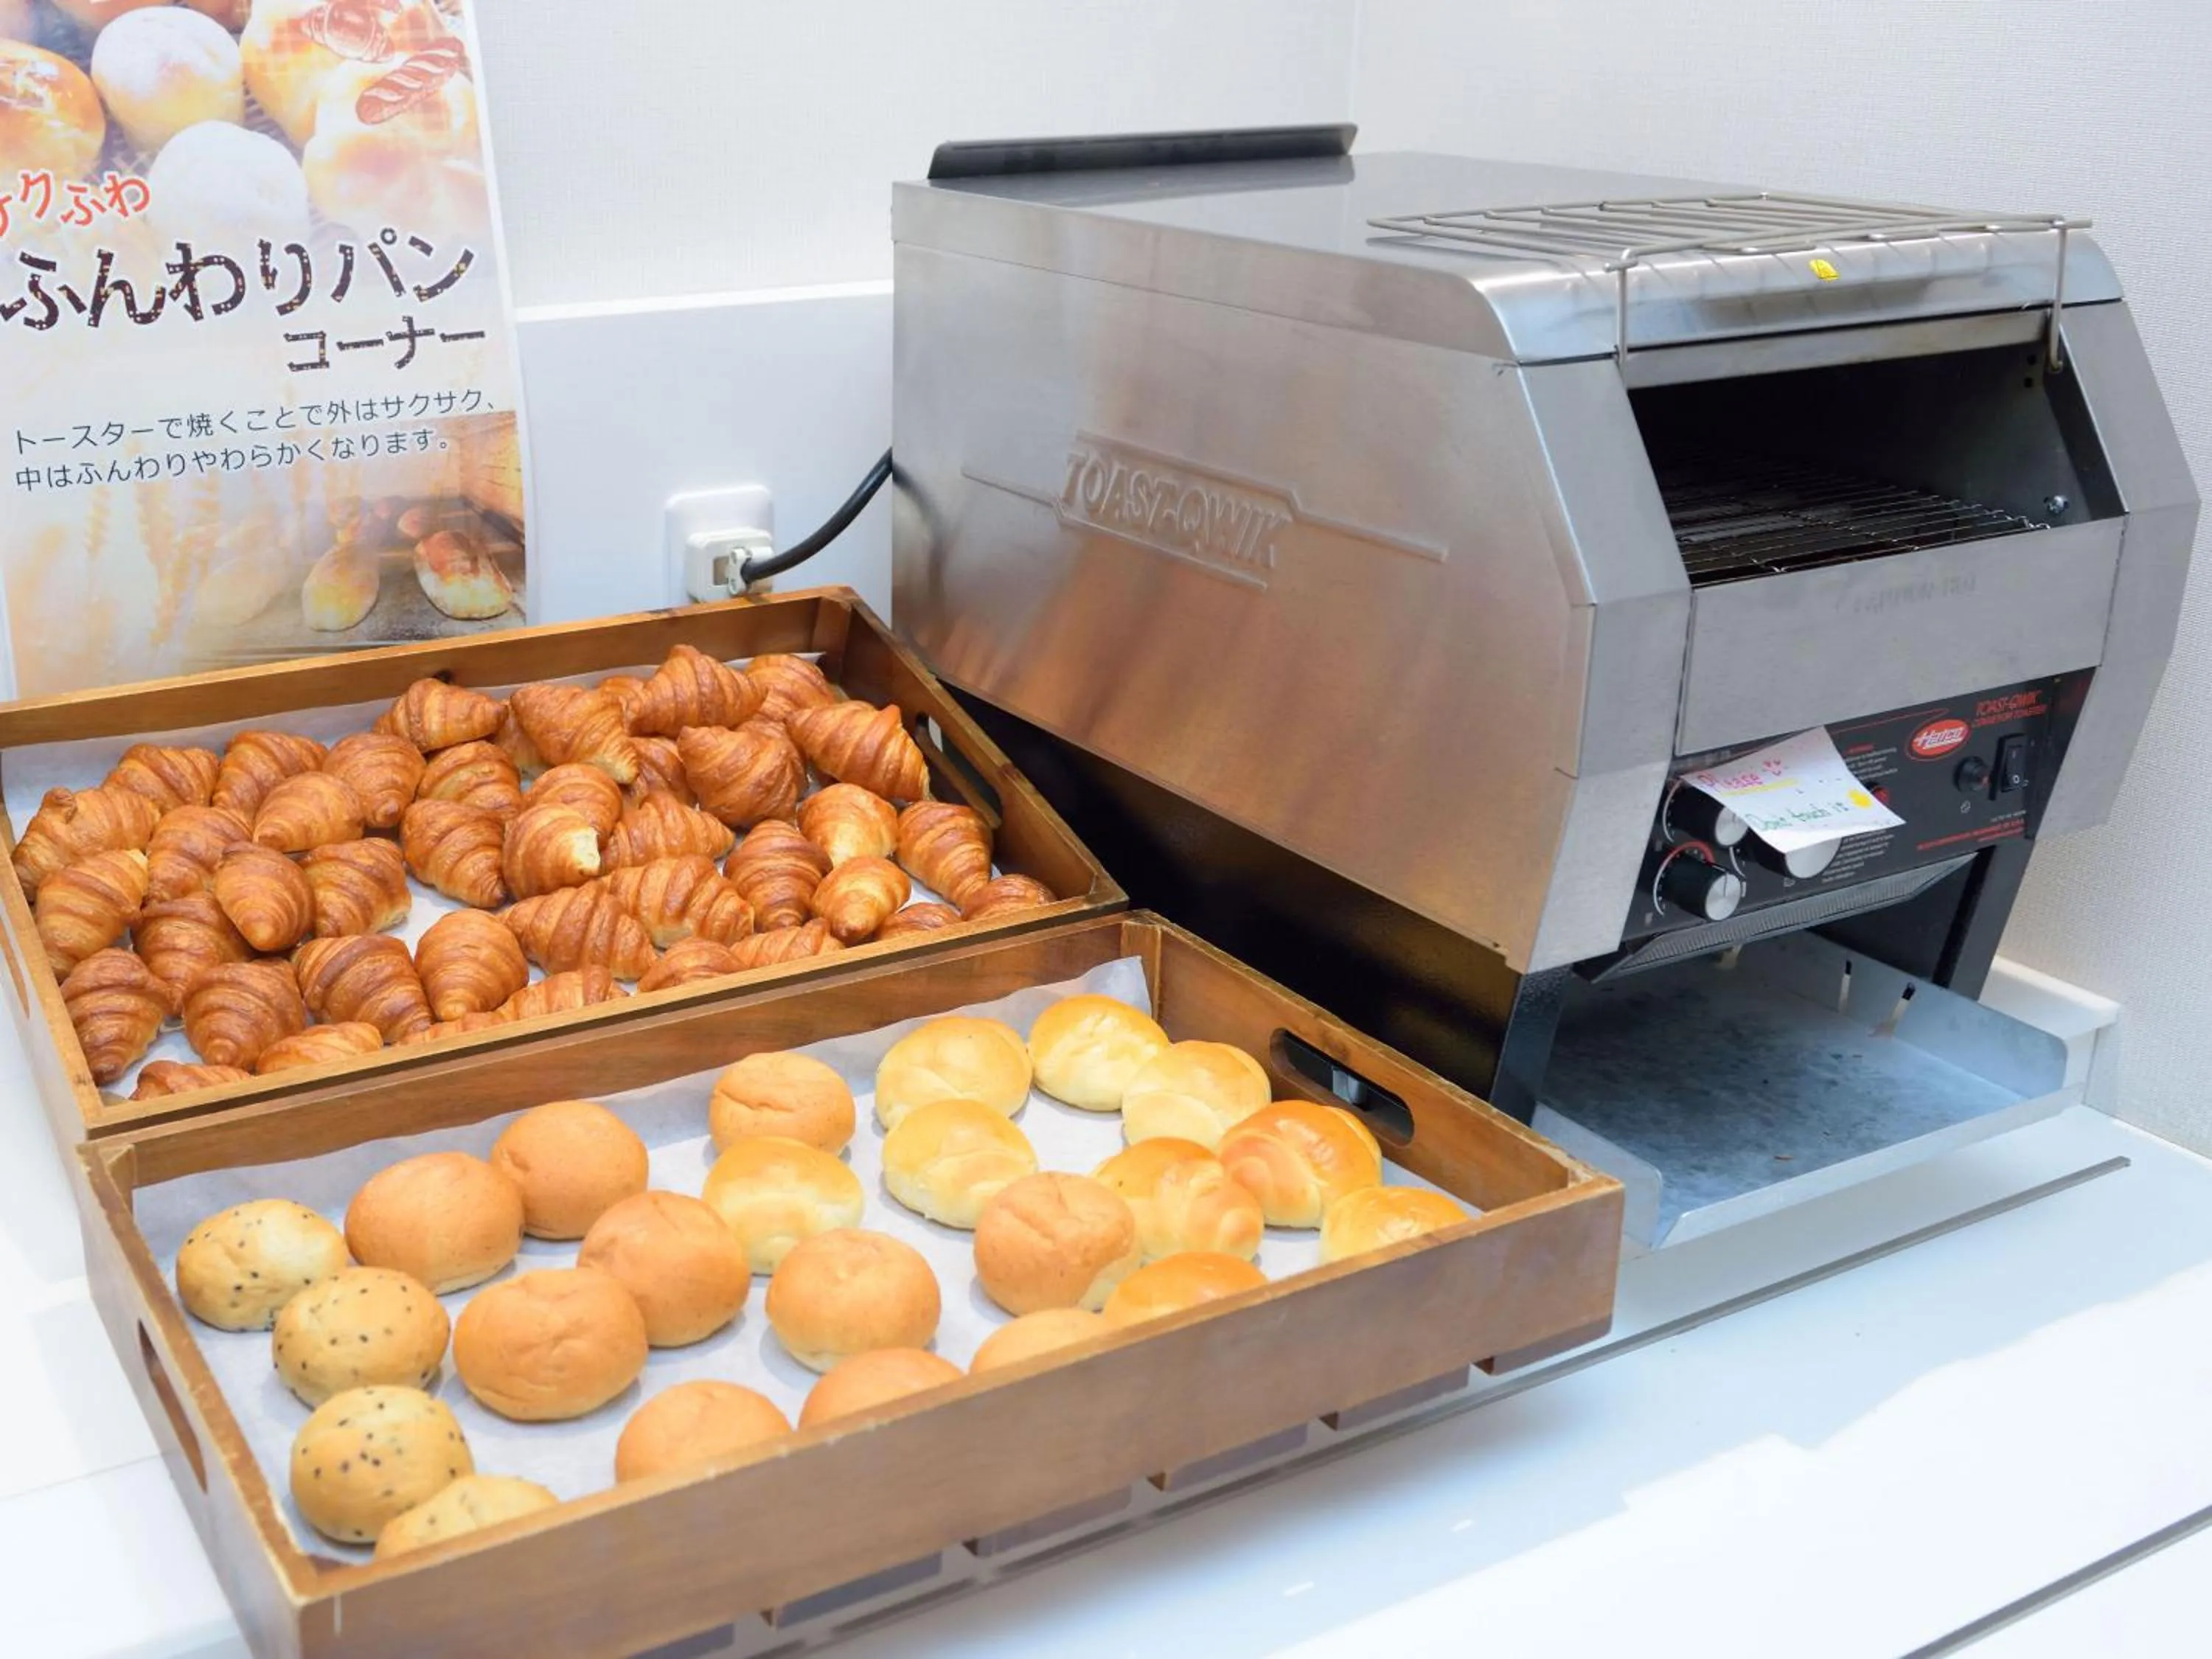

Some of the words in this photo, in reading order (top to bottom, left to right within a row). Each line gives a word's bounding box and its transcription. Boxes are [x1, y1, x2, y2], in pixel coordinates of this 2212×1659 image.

[0, 227, 474, 330] ふんわりパン
[283, 315, 485, 372] コーナー
[16, 389, 496, 454] トースターで焼くことで外はサクサク、
[16, 428, 448, 491] 中はふんわりやわらかくなります。
